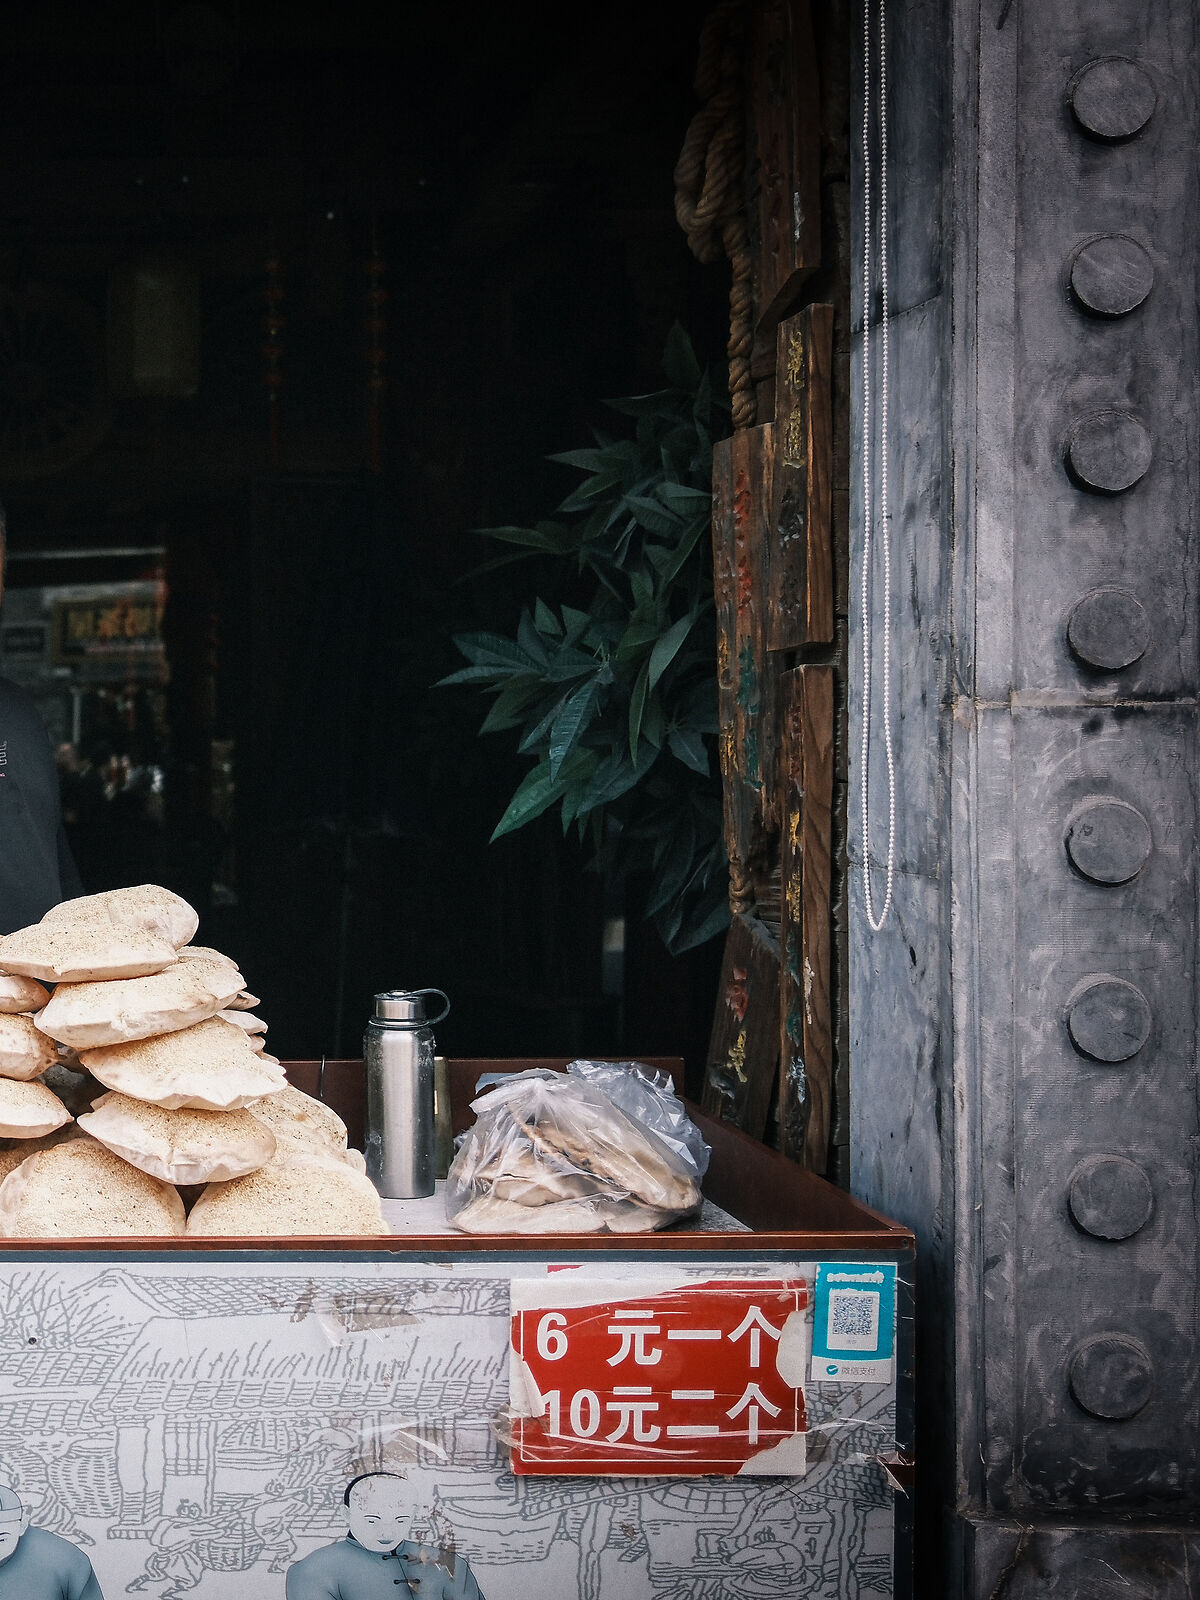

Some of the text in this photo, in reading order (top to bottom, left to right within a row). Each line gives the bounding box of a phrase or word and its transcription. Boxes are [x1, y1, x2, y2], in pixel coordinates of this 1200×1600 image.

[841, 1366, 876, 1376] 微信支付
[544, 1381, 782, 1445] 10元二个
